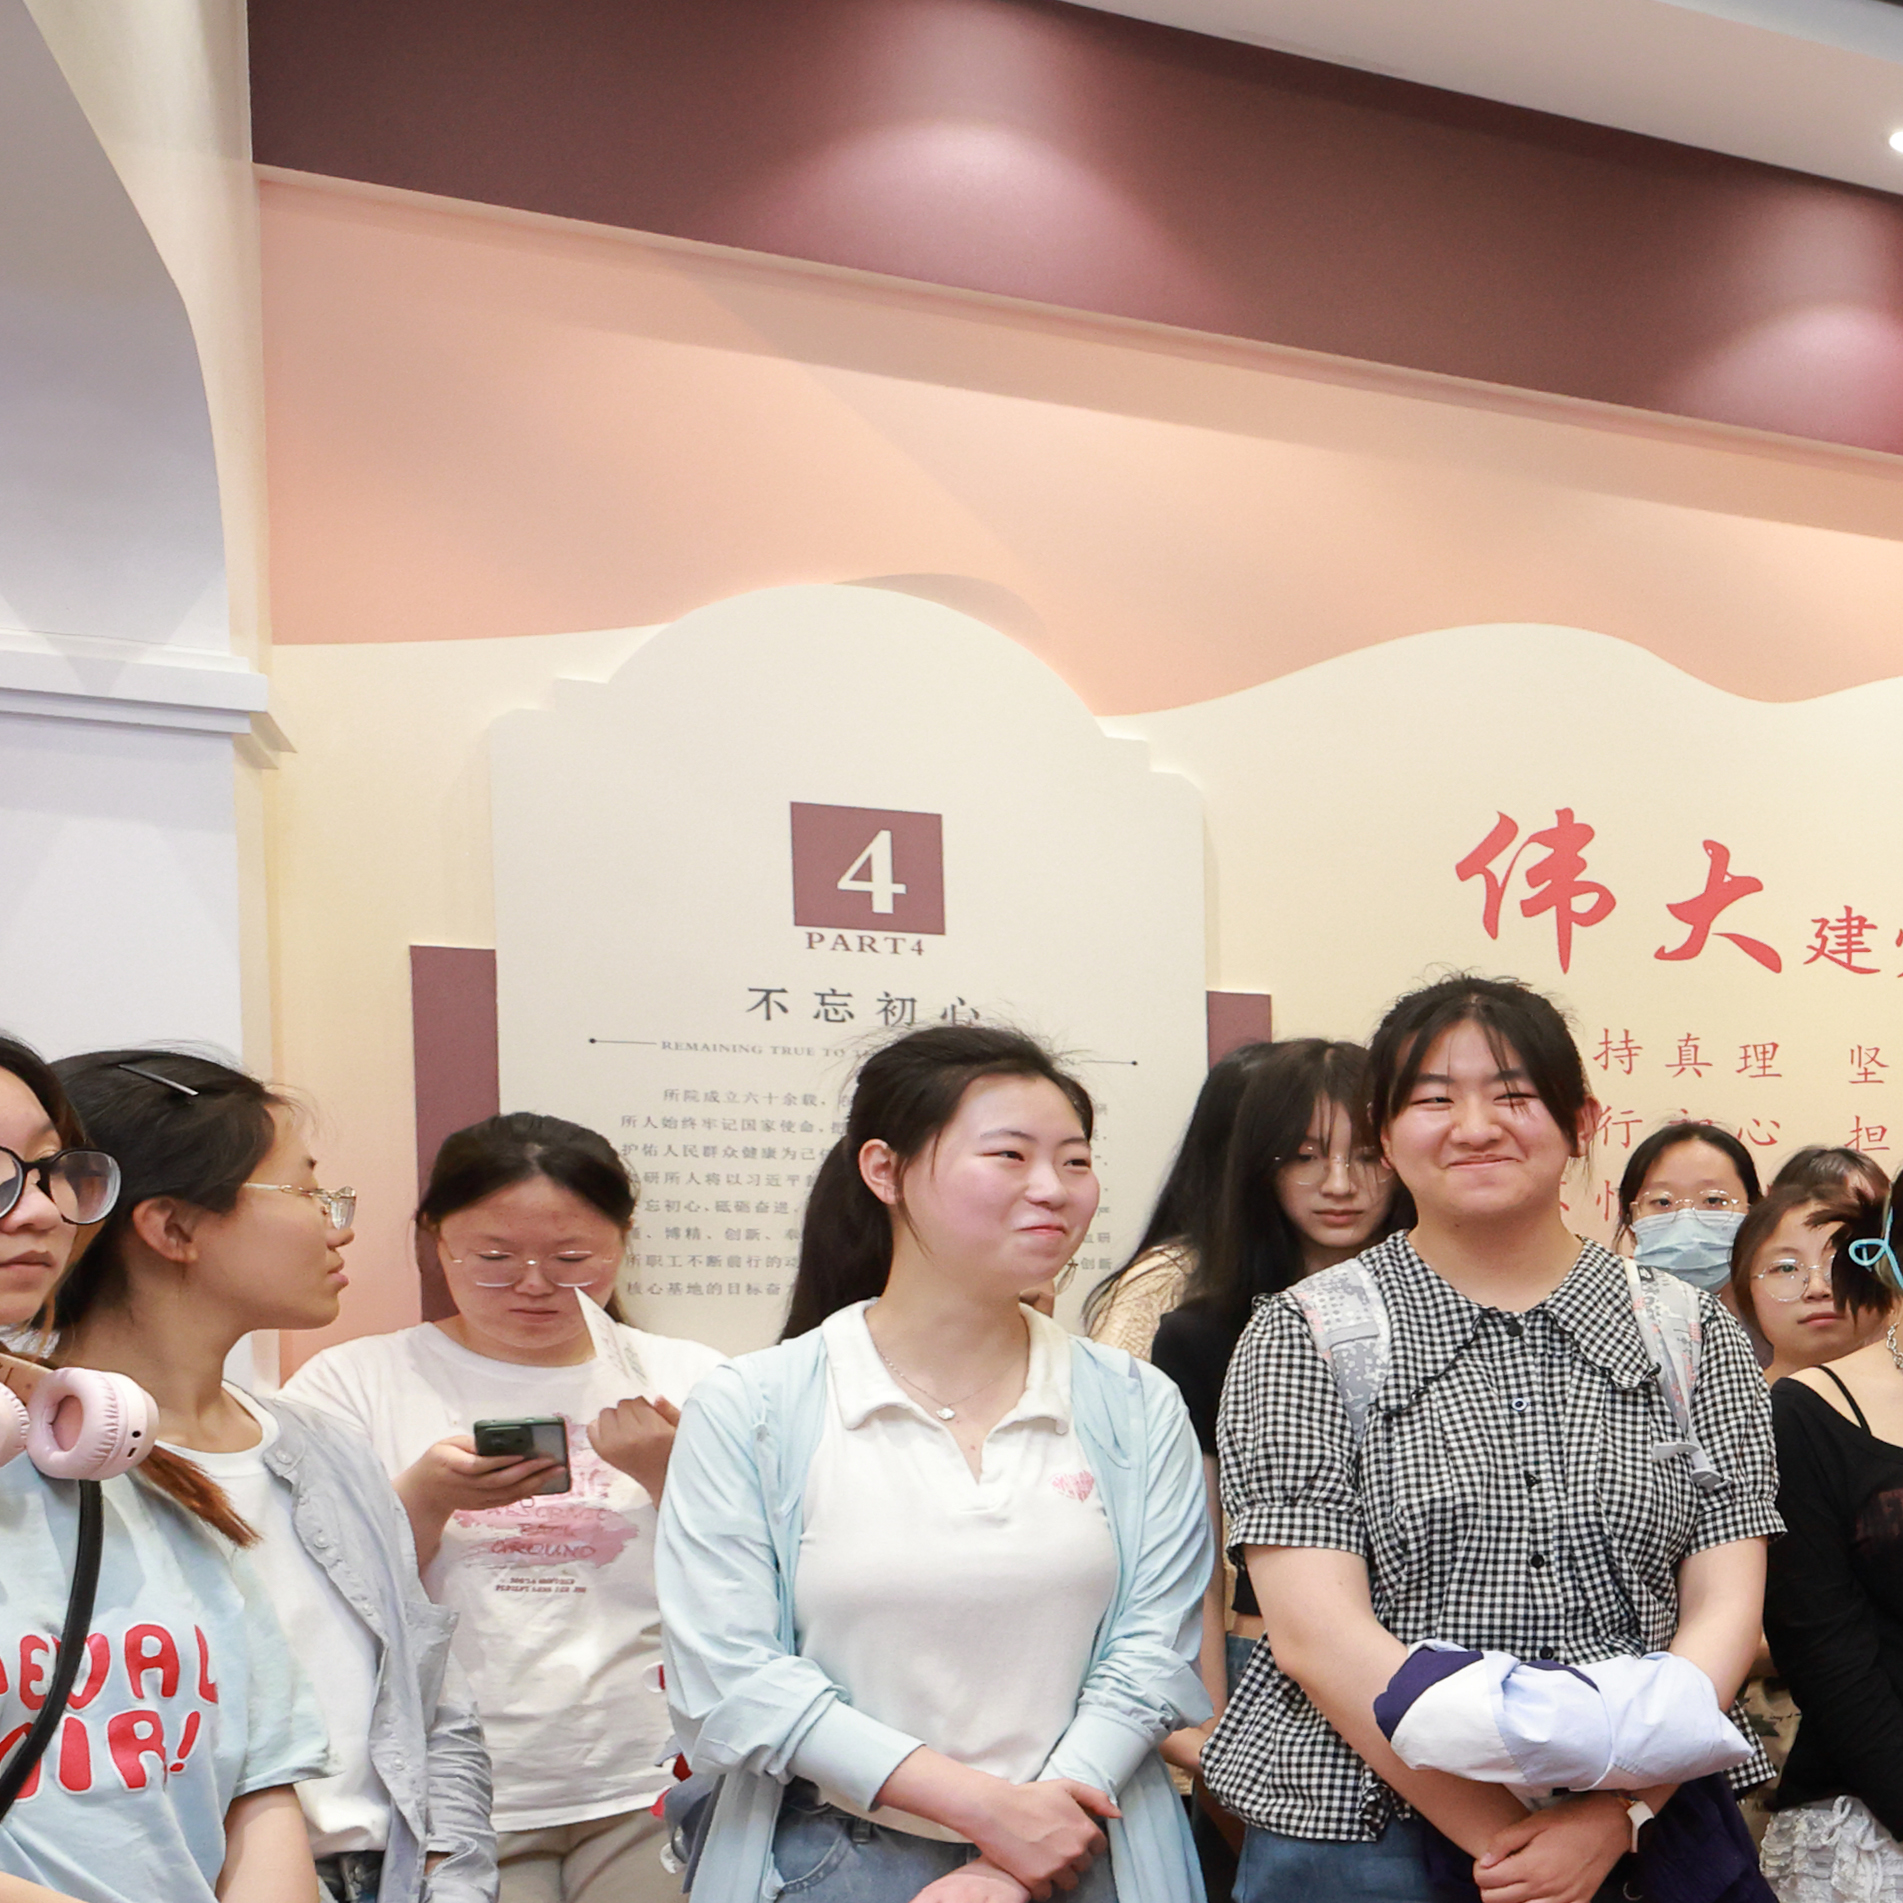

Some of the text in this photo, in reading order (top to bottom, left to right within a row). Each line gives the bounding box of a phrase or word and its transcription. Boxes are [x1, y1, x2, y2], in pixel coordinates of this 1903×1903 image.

[835, 828, 908, 915] 4
[804, 930, 927, 958] PART4
[661, 1039, 764, 1056] REMAINING
[770, 1044, 816, 1057] TRUE
